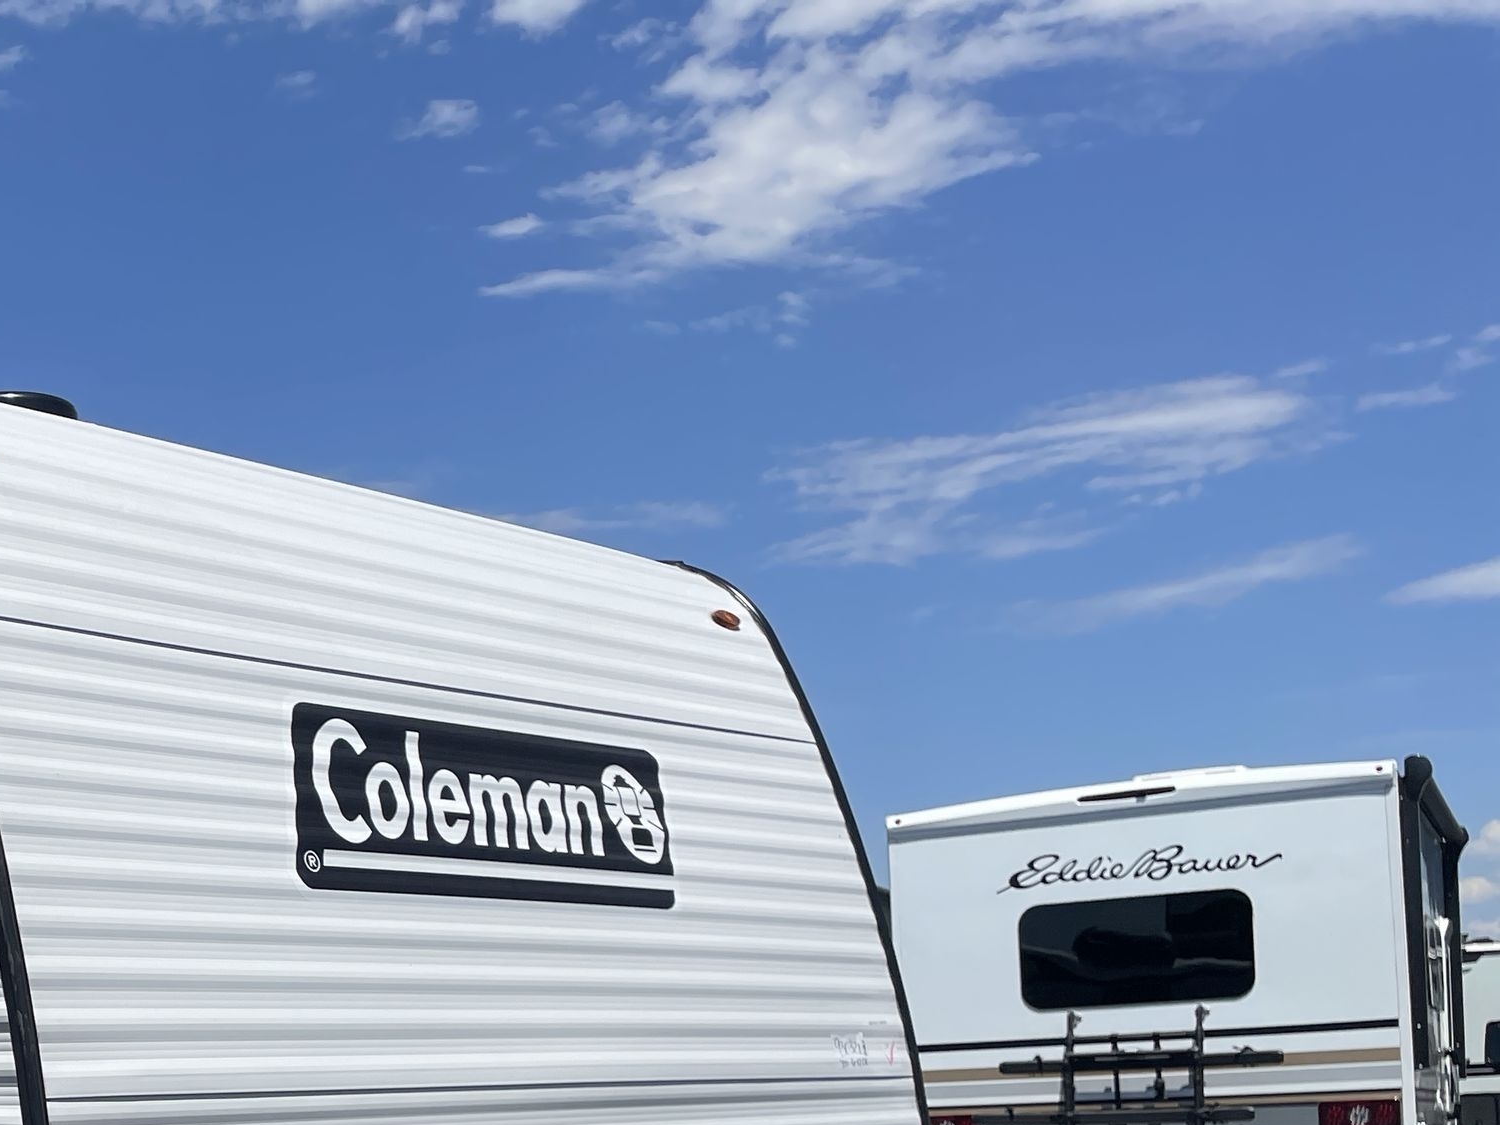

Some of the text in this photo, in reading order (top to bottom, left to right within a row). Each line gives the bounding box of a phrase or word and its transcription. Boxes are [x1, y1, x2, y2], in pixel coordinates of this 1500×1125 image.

[312, 717, 605, 857] Coleman
[996, 845, 1283, 894] Eddie Bauer
